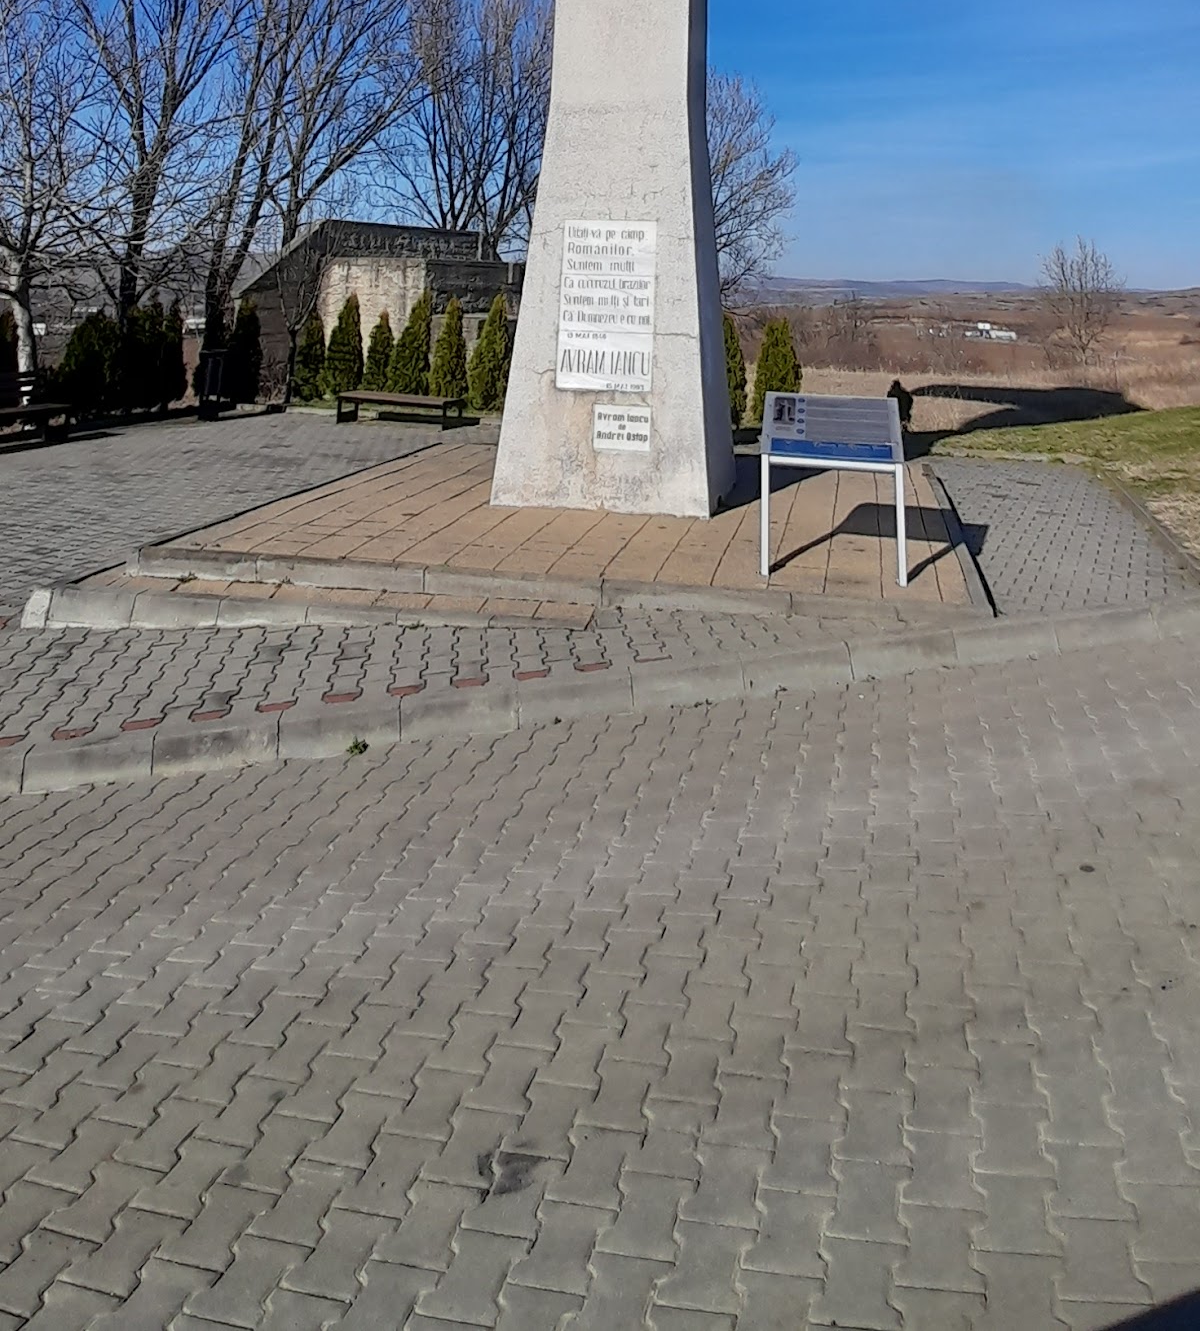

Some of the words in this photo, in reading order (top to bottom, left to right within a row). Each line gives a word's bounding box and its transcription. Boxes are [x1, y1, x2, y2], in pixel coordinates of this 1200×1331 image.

[606, 229, 616, 242] pe
[567, 258, 602, 270] Suntem
[620, 314, 625, 324] e
[626, 315, 636, 325] cu
[560, 349, 606, 374] AVRAM
[610, 351, 650, 376] IANCU
[596, 431, 624, 440] Andrei
[626, 432, 648, 443] Ostap
